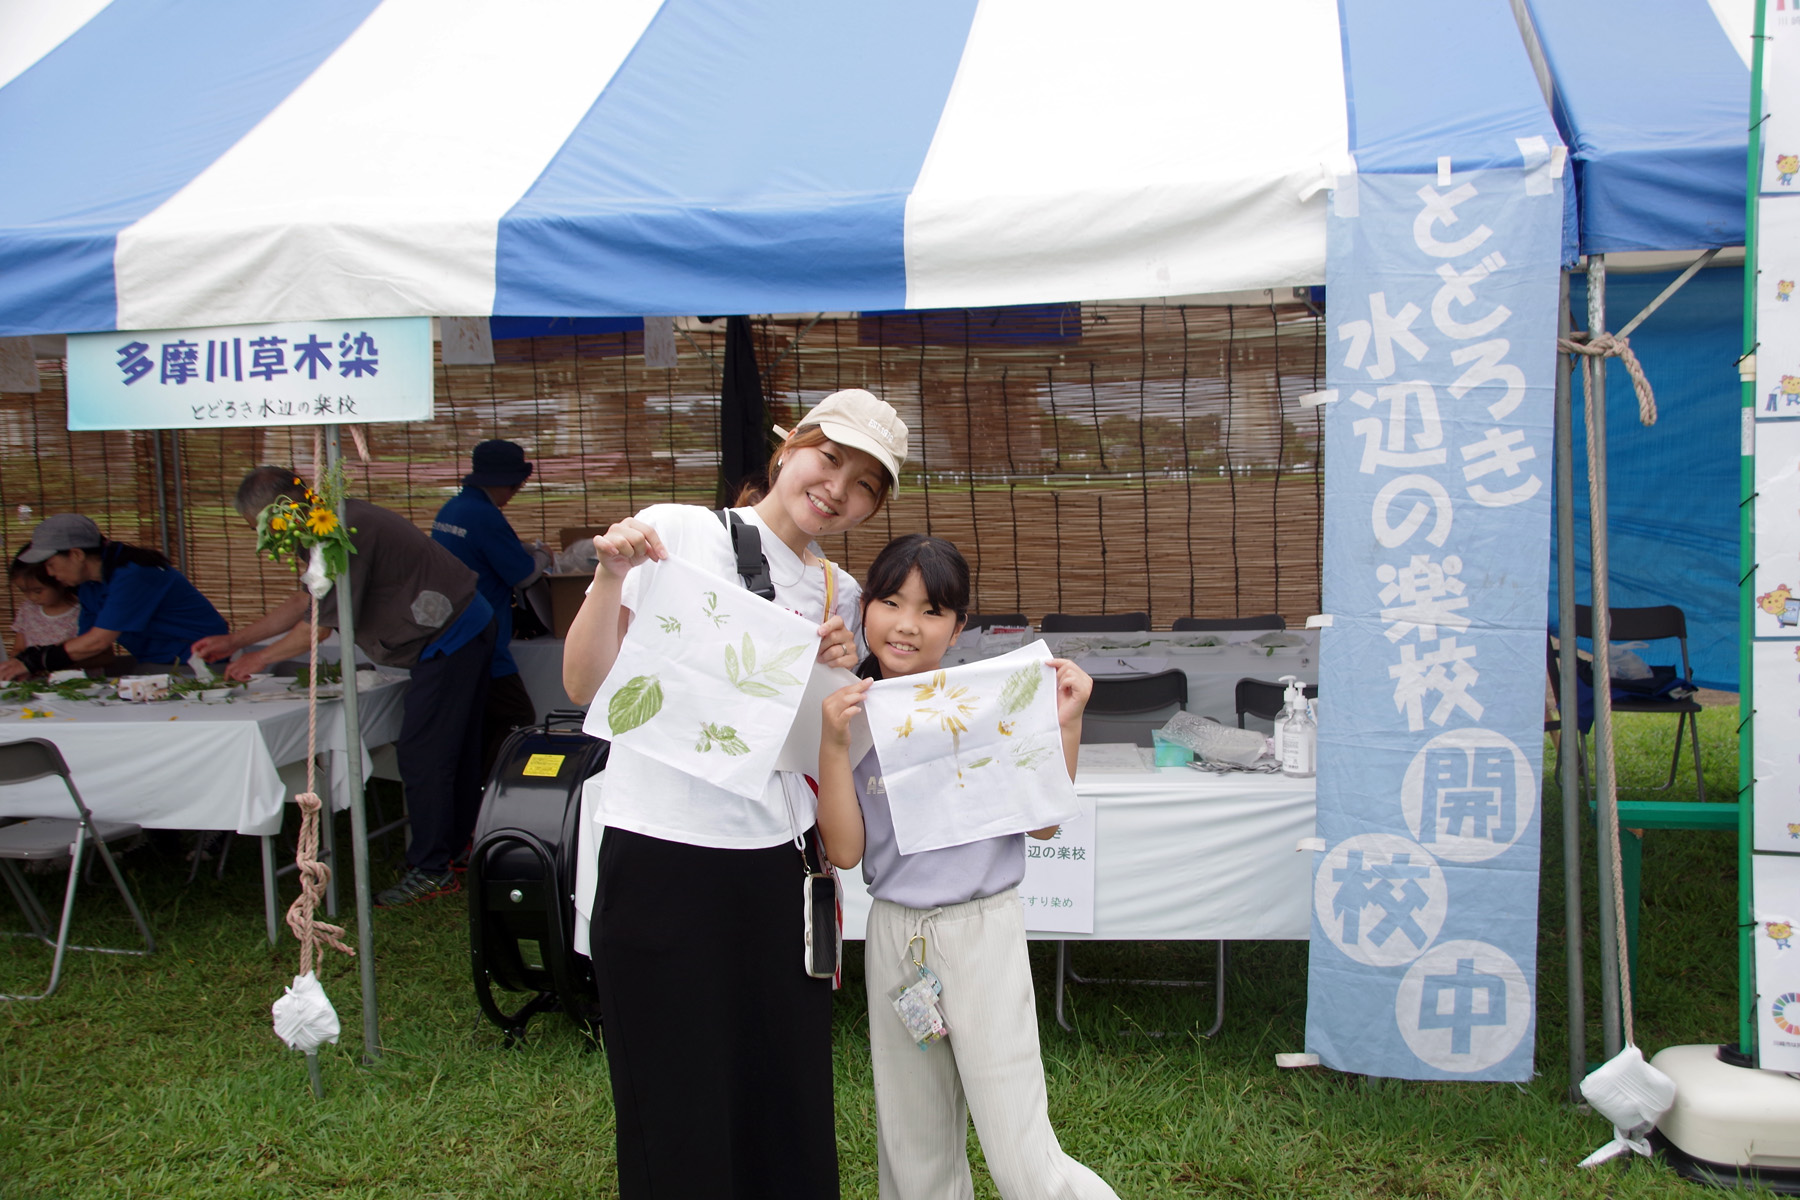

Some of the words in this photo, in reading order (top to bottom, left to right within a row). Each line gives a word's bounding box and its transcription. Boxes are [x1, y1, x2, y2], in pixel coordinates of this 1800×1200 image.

[116, 331, 379, 386] 多摩川草木染
[1412, 181, 1543, 508] とどろき
[190, 394, 359, 421] とどろき水辺の楽校
[1337, 290, 1486, 733] 水辺の楽校
[1025, 845, 1086, 861] 辺の楽校
